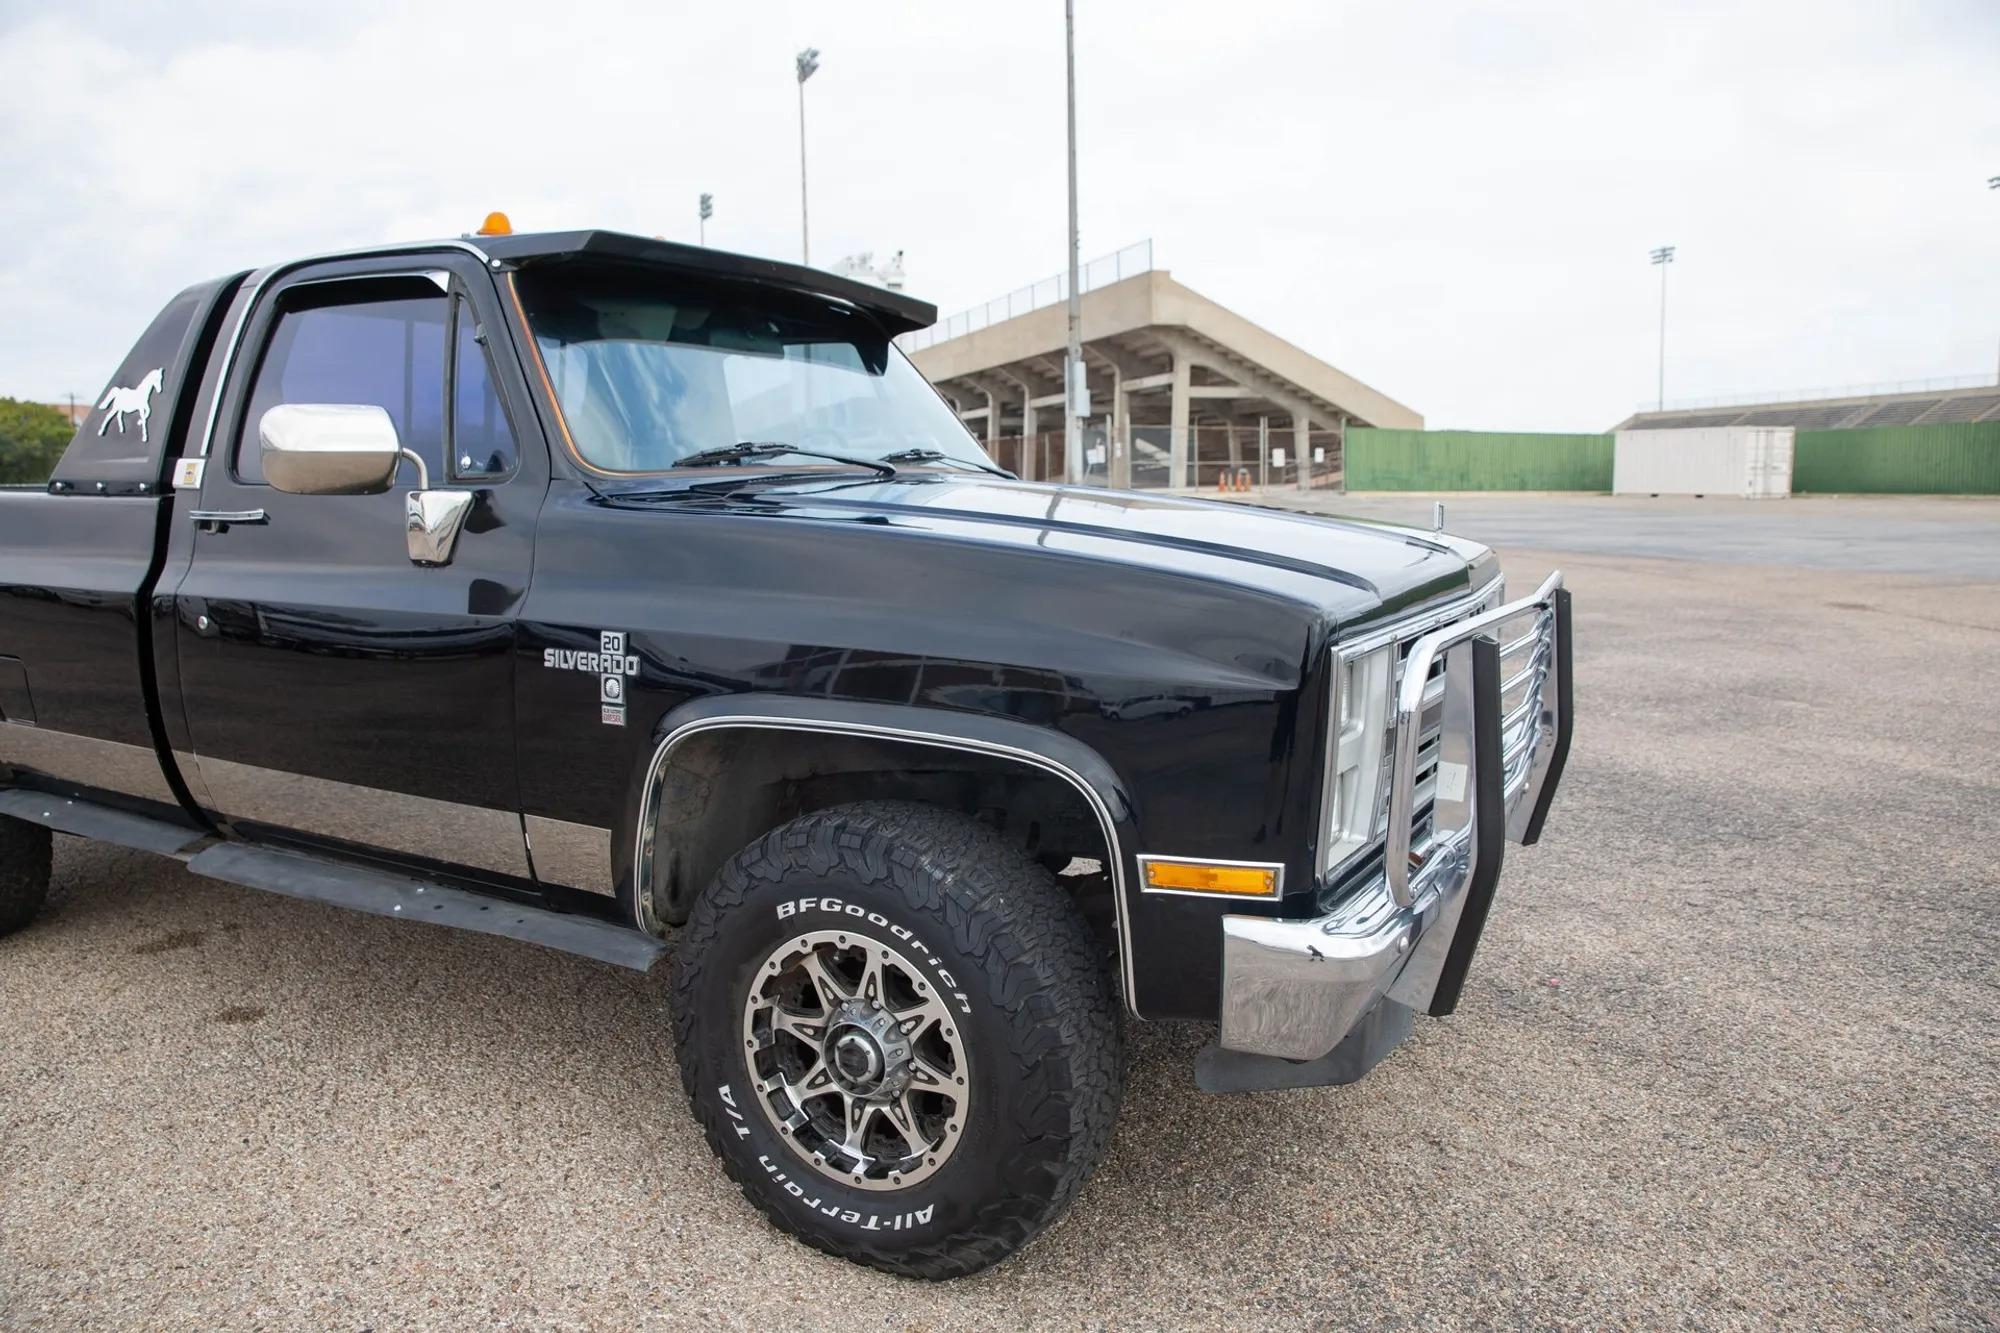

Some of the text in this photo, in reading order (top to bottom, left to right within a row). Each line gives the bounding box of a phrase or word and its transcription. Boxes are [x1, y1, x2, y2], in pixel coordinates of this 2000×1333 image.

[544, 648, 639, 675] SILVERADO
[603, 636, 620, 651] 20
[776, 897, 972, 1014] BFGoodrich
[718, 1084, 935, 1231] All-Terrain T/A
